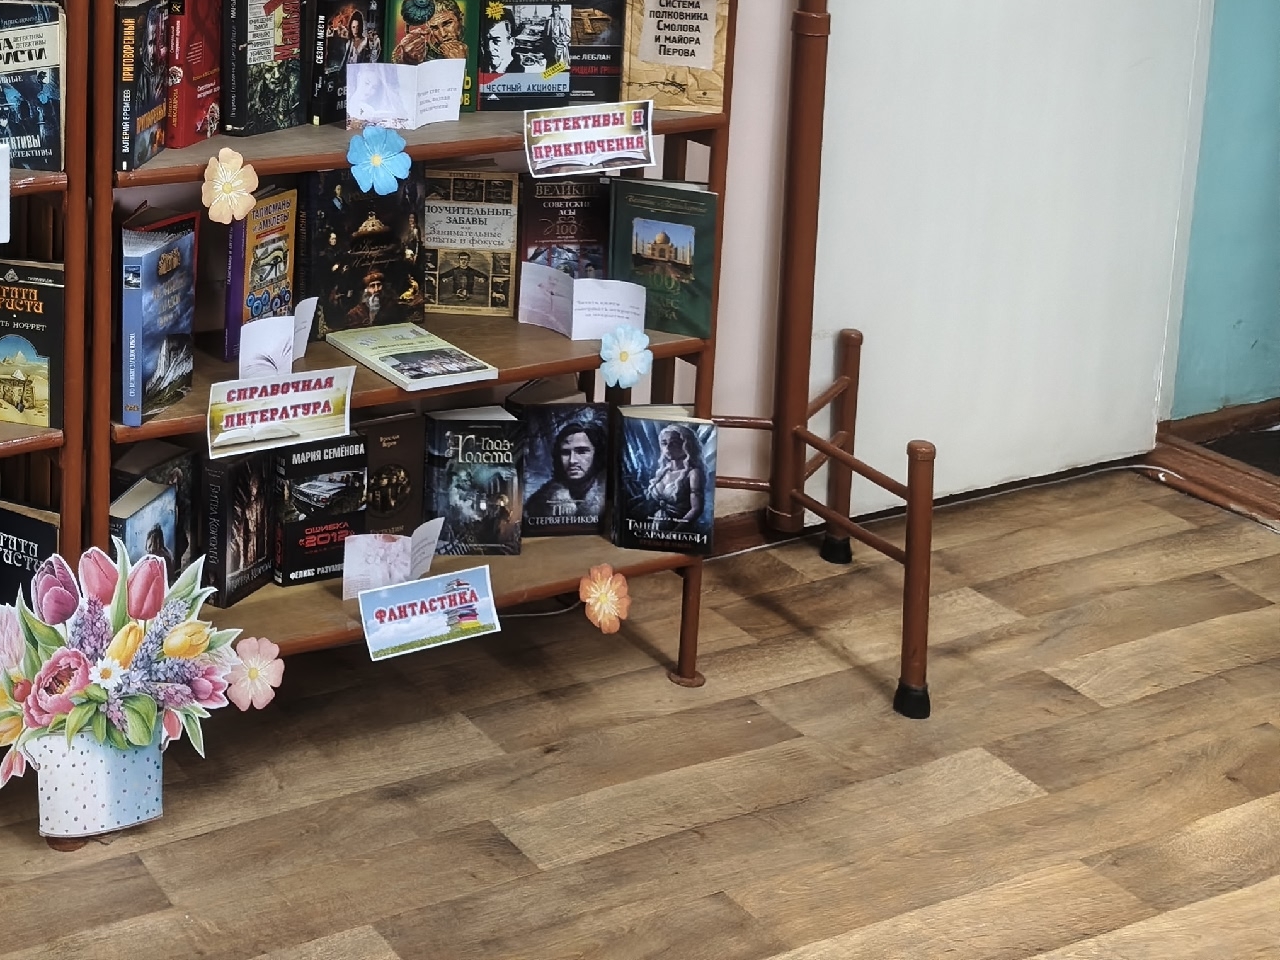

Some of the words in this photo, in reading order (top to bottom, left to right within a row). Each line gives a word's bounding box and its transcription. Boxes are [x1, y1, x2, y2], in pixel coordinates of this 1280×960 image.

[318, 15, 326, 38] МЕСТИ
[122, 18, 135, 82] ПРИГОВОРЕННЫЙ
[315, 39, 324, 64] СЕЗОН
[581, 53, 612, 61] ЛЕБЛАН
[486, 83, 522, 92] ЧЕСТНЫЙ
[526, 83, 567, 92] АКЦИОНЕР
[532, 112, 625, 136] ДЕТЕКТИВЫ
[121, 121, 131, 153] ВАЛЕРИЙ
[533, 135, 645, 161] ПРИКЛЮЧЕНИЯ
[425, 205, 512, 217] ПОУЧИТЕЛЬНЫЕ
[445, 216, 488, 226] ЗАБАВЫ
[426, 236, 457, 246] опыты
[468, 236, 505, 248] фокусы
[13, 321, 47, 331] НОФРЕТ
[226, 376, 334, 403] СПРАВОЧНАЯ
[223, 399, 333, 429] ЛИТЕРАТУРА
[292, 449, 322, 465] МАРИЯ
[323, 443, 365, 461] СЕМЁНОВА
[305, 522, 349, 535] ОШИБКА
[289, 565, 317, 580] ФЕЛИКС
[373, 589, 479, 624] ФАНТАСТИКА
